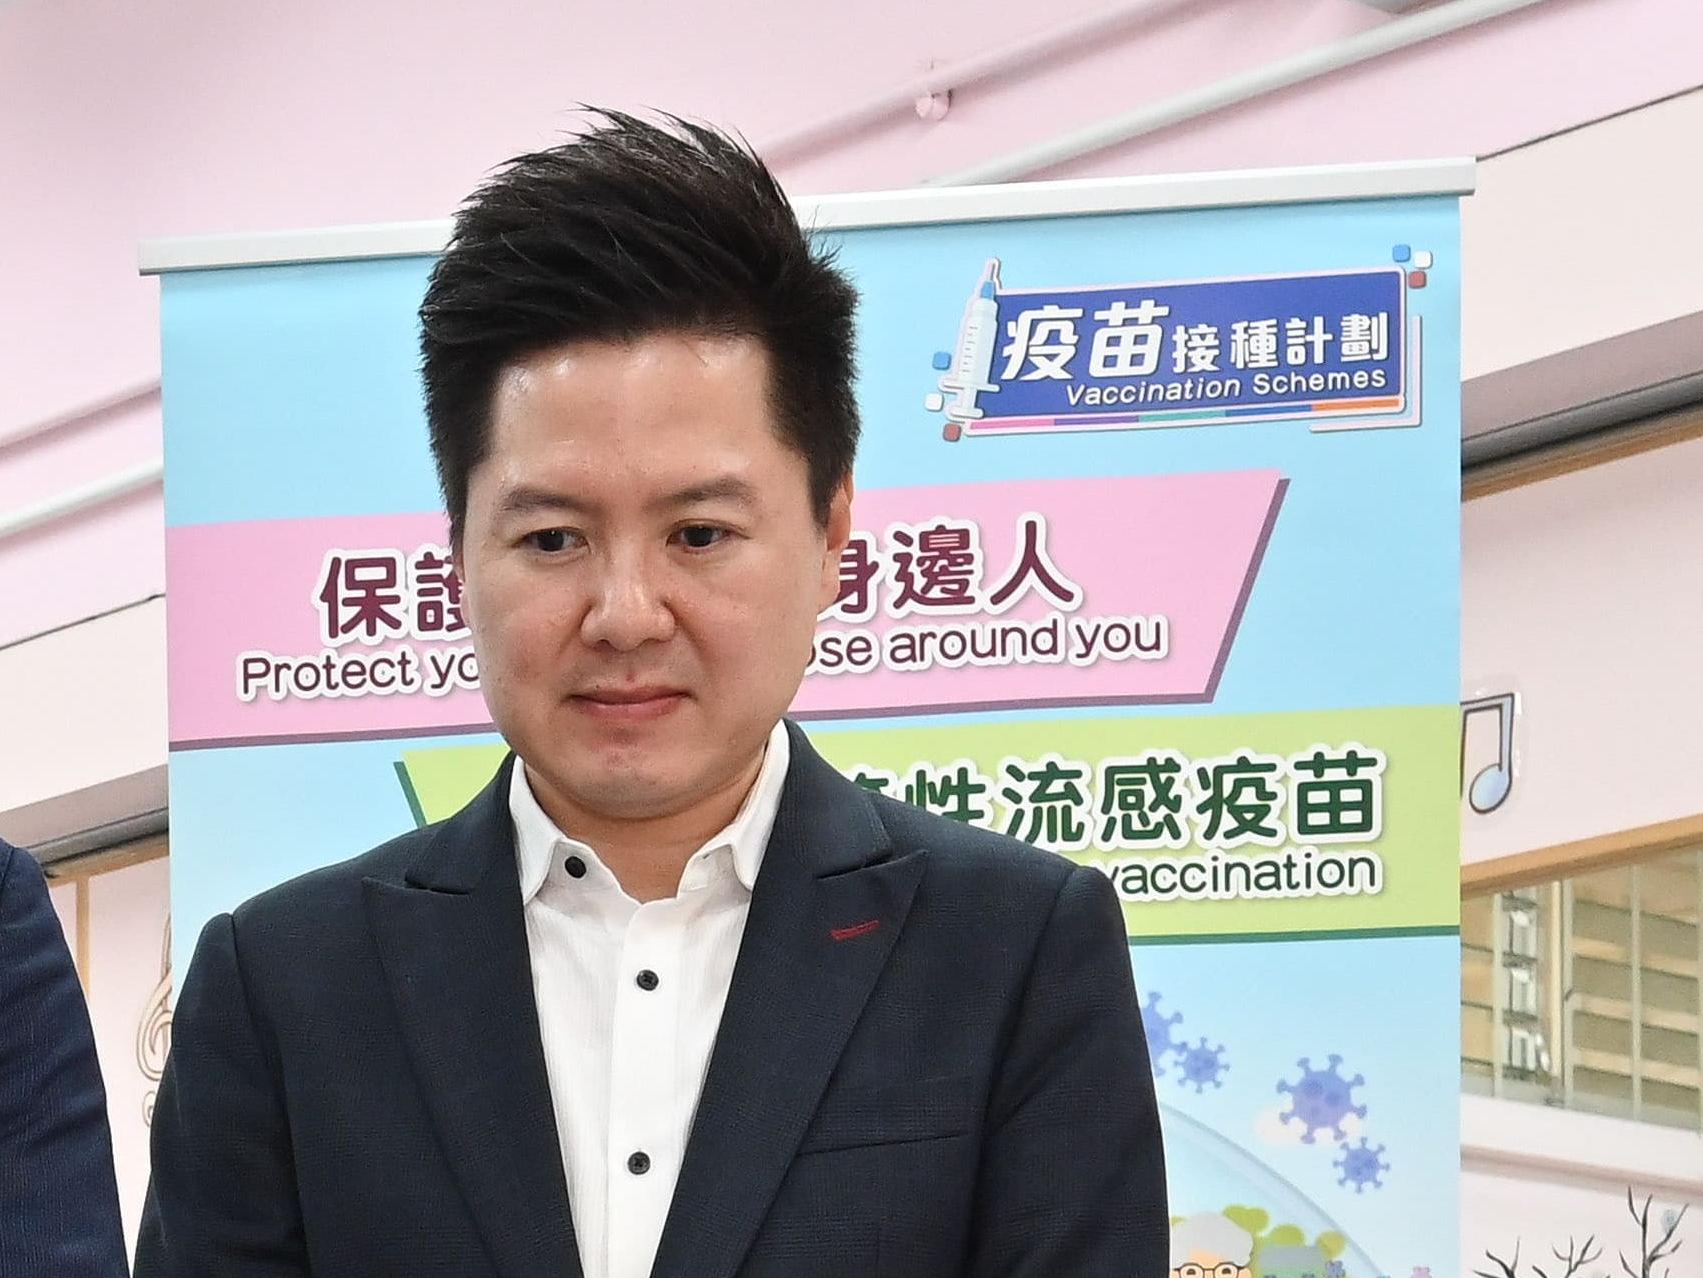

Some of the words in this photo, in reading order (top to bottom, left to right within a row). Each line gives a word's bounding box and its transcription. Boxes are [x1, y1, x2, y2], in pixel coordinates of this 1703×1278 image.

[1001, 299, 1388, 381] 疫苗接種計劃
[1066, 378, 1241, 406] Vaccination
[1253, 369, 1386, 394] Schemes
[833, 520, 1075, 613] 身邊人
[243, 651, 415, 694] Protect
[890, 618, 1058, 663] around
[1075, 621, 1161, 658] you
[855, 750, 1378, 845] 性流感疫苗
